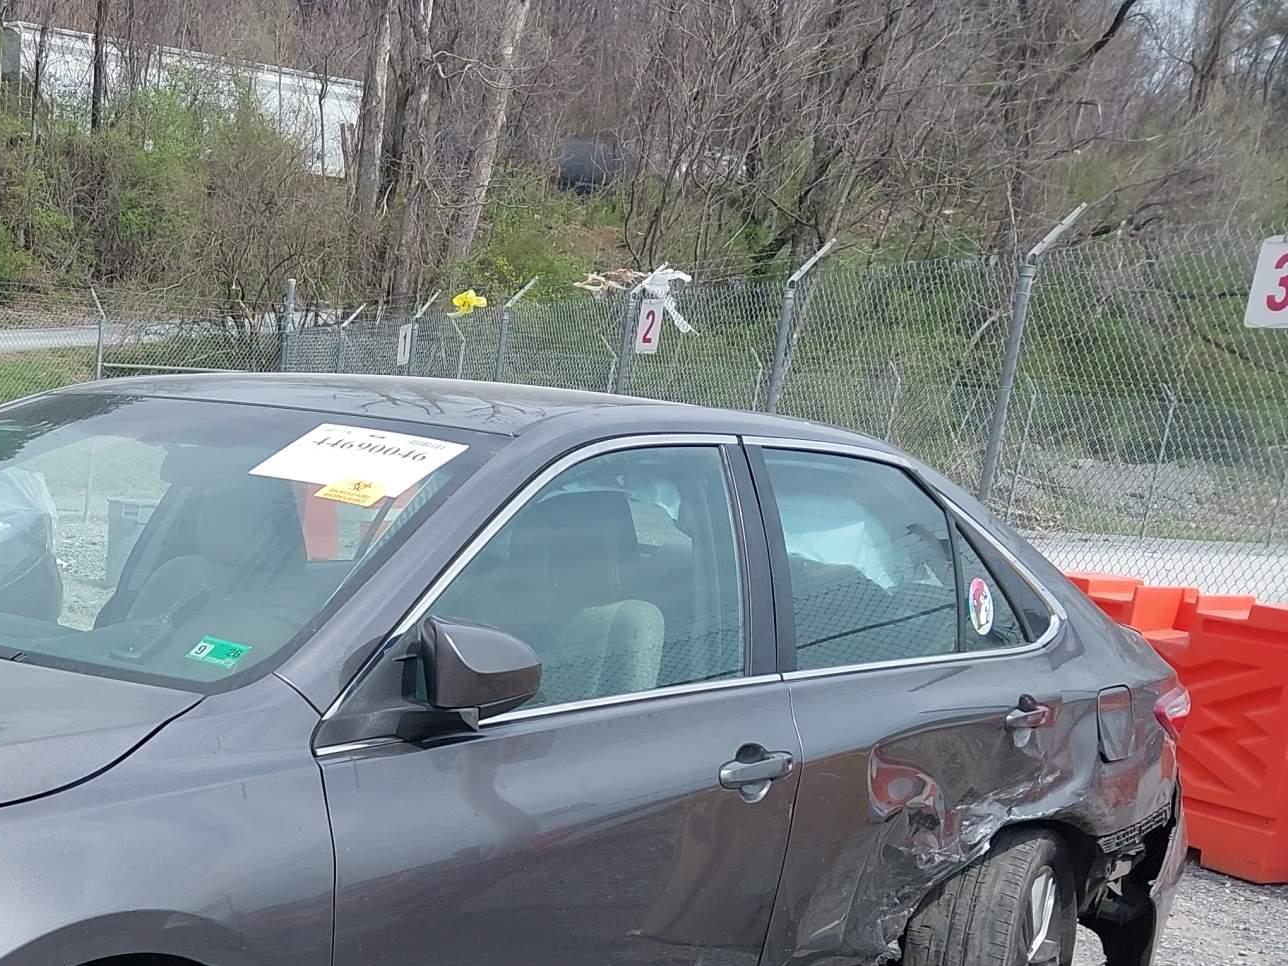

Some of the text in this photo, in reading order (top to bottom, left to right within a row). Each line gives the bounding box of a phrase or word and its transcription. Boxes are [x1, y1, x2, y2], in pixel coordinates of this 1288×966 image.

[642, 310, 655, 343] 2
[401, 331, 408, 350] 1
[313, 436, 427, 462] 44690046
[195, 645, 243, 657] 9 26
